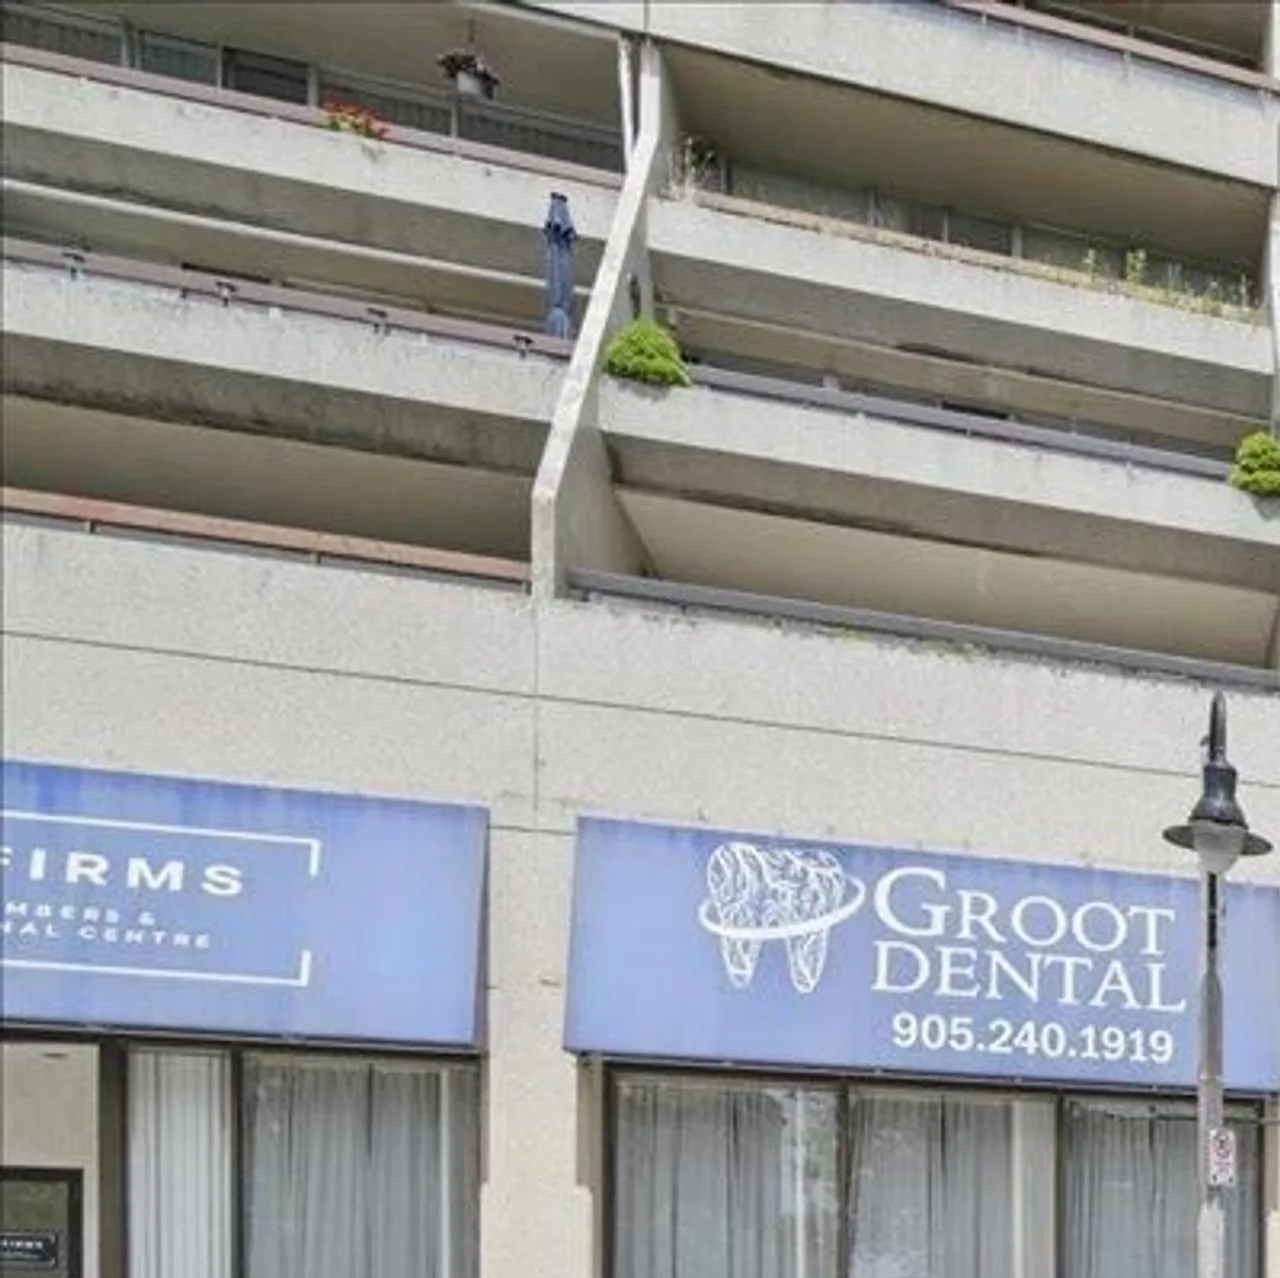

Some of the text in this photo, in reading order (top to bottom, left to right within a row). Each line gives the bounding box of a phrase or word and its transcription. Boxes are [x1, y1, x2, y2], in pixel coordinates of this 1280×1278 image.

[873, 866, 1177, 957] GROOT
[870, 939, 1188, 1013] DENTAL
[891, 1011, 1174, 1065] 905.240.1919
